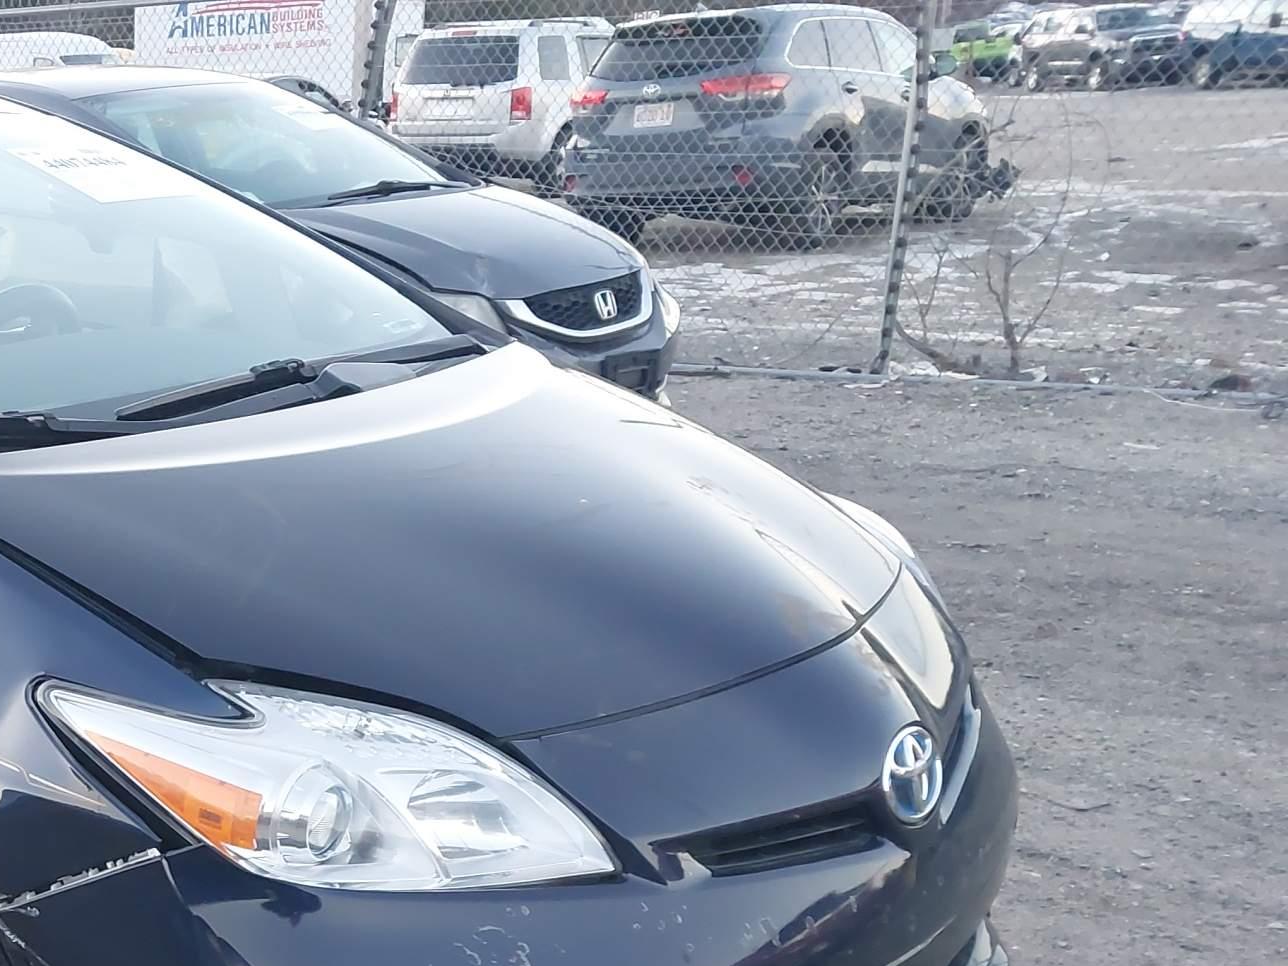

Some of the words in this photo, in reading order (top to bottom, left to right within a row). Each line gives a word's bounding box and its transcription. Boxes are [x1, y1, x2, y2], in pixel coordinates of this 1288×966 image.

[168, 2, 271, 38] AMERICAN
[272, 8, 323, 21] BUILDING
[272, 20, 324, 33] SYSTEMS
